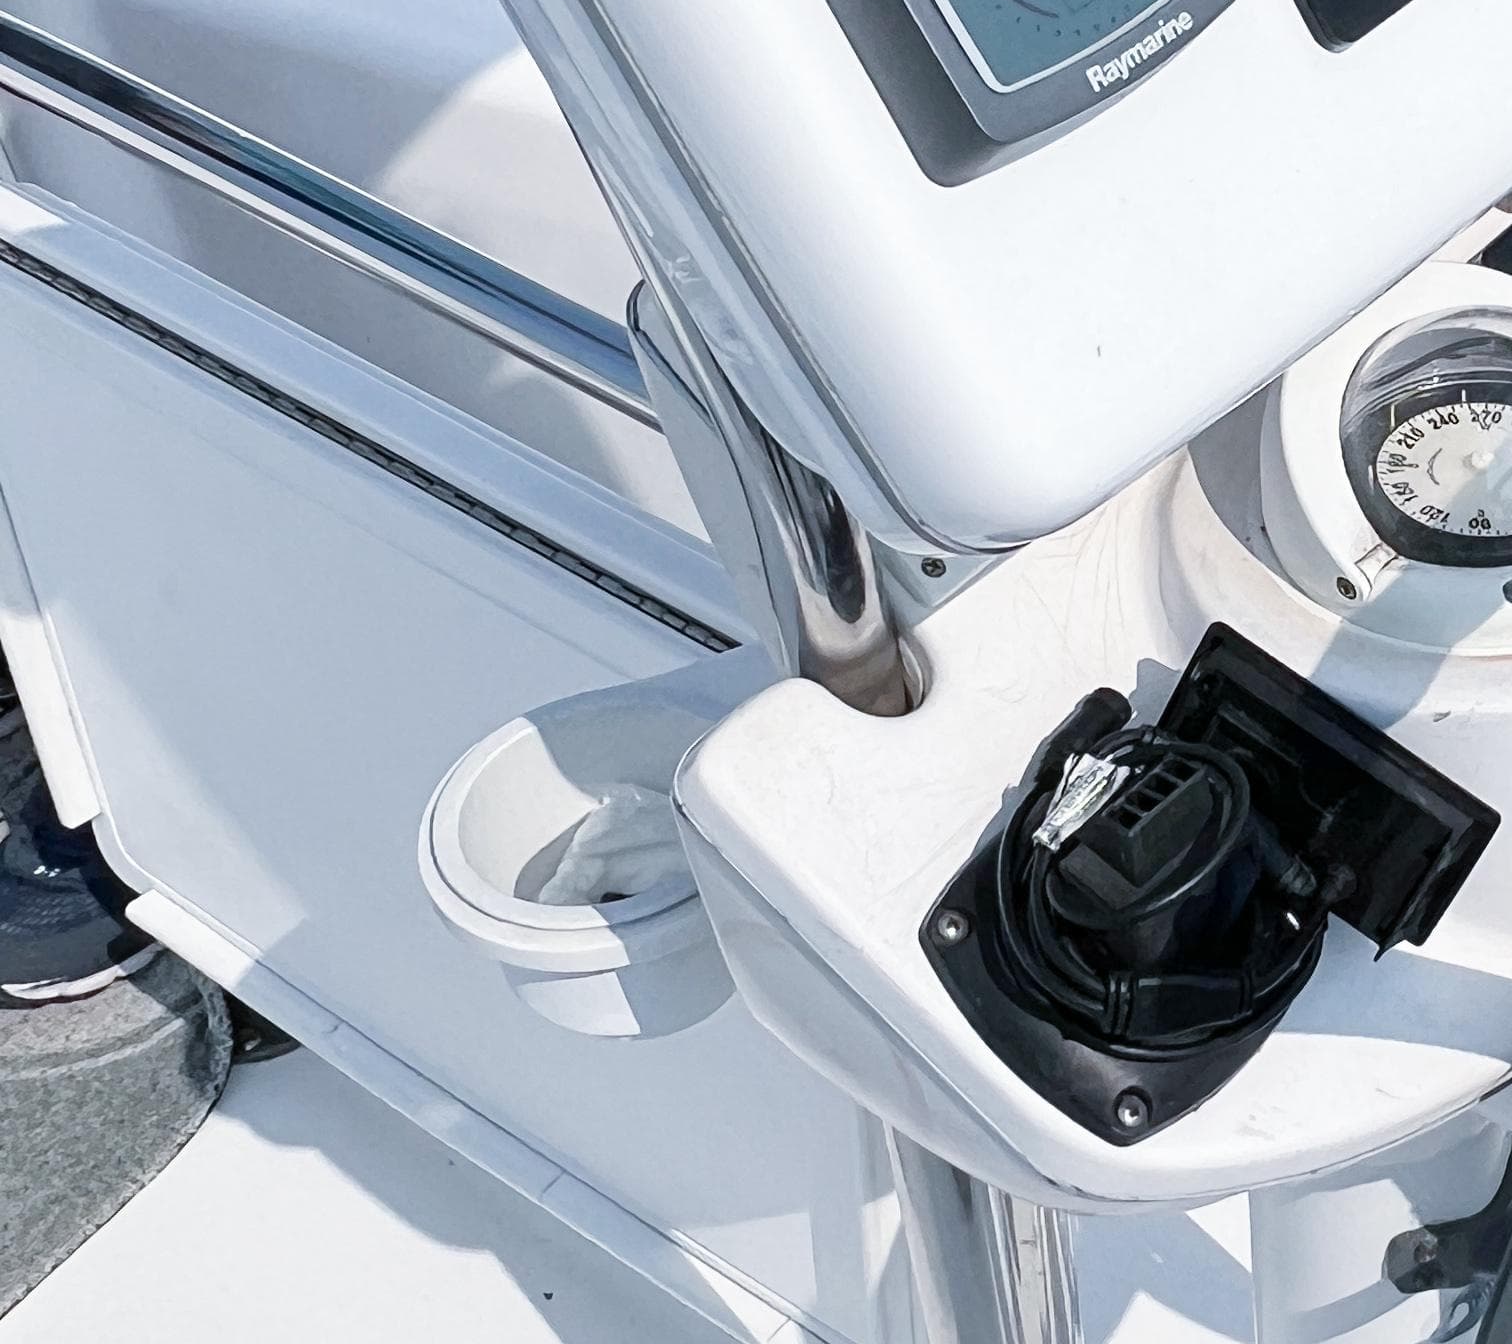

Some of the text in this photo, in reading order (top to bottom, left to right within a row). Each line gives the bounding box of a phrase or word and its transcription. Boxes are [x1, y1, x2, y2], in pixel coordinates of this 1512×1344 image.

[1085, 11, 1194, 93] Raymarine
[1426, 412, 1460, 430] 240
[1396, 427, 1425, 449] 210
